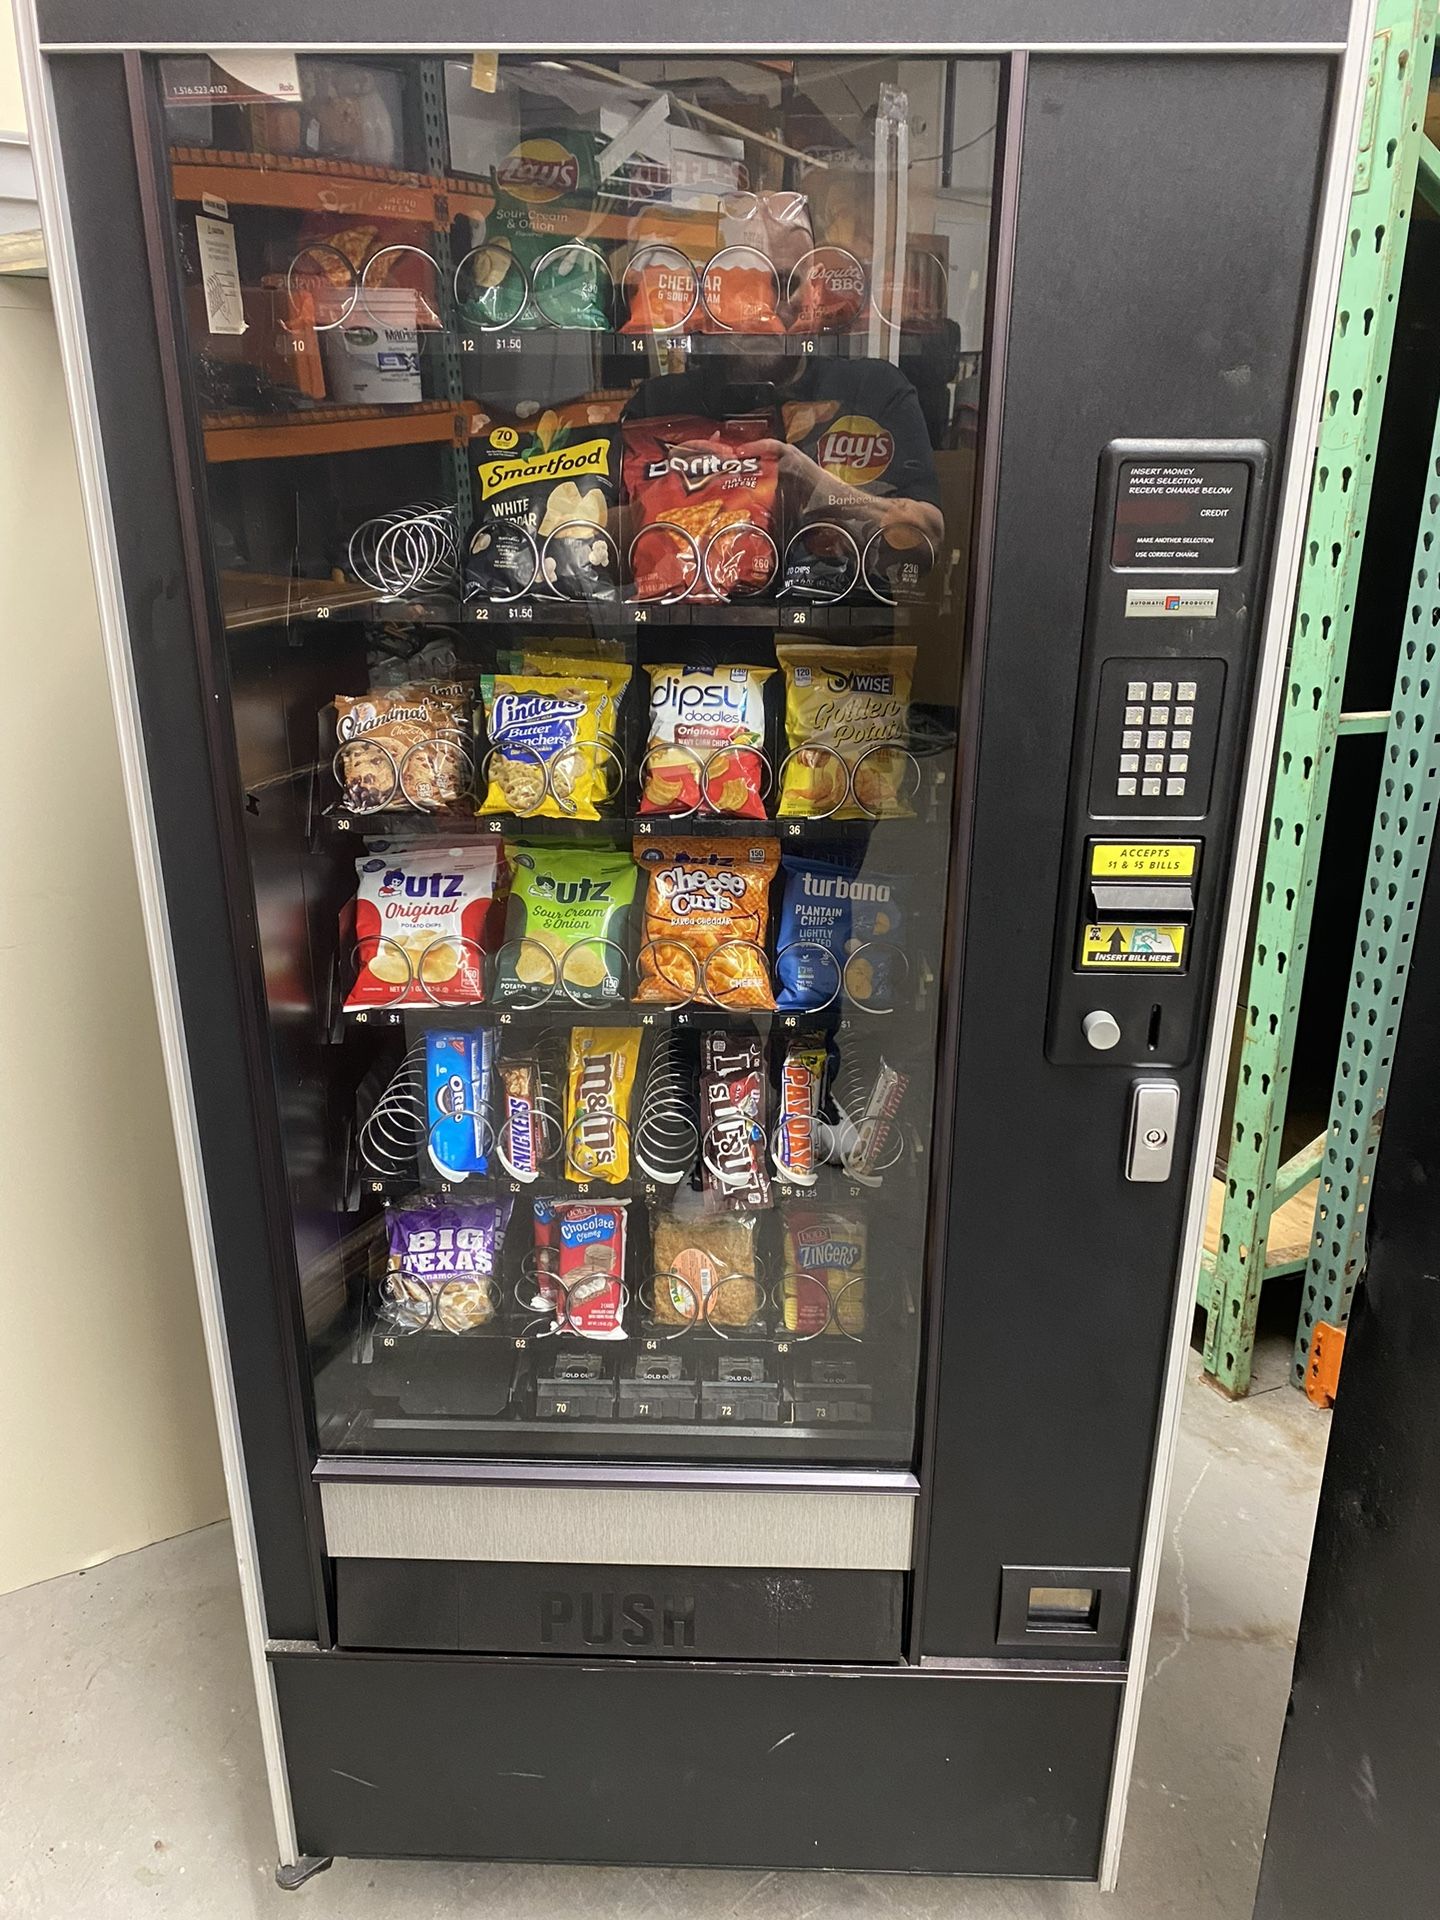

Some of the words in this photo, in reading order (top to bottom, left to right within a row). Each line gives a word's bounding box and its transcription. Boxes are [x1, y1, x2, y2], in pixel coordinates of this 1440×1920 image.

[173, 85, 228, 95] 1.516.523.4102
[279, 83, 294, 91] Rob
[501, 157, 574, 187] Lay's
[496, 209, 525, 220] Sour
[528, 210, 568, 222] Cream
[507, 219, 516, 229] &
[519, 219, 555, 231] Onion
[659, 274, 721, 291] CHEDAR
[831, 278, 863, 297] BBQ
[667, 291, 688, 302] SOUR
[292, 341, 305, 351] 10
[462, 340, 474, 350] 12
[496, 339, 521, 350] $1.50
[631, 339, 643, 351] 14
[802, 341, 813, 352] 16
[497, 430, 512, 442] 70
[823, 433, 888, 468] Lay's
[488, 447, 603, 487] Smartfood
[648, 456, 758, 478] Doritos
[1201, 487, 1233, 495] BELOW
[492, 499, 529, 517] WHITE
[1200, 509, 1229, 517] CREDIT
[753, 559, 769, 569] 260
[317, 607, 330, 618] 20
[476, 609, 488, 619] 22
[509, 608, 532, 619] $1.50
[634, 611, 646, 621] 24
[794, 613, 805, 623] 26
[796, 668, 810, 677] 120
[857, 676, 890, 693] WISE
[651, 677, 748, 722] dipsy
[492, 694, 588, 725] Linden's
[814, 698, 901, 731] Golden
[685, 710, 739, 723] doodles
[337, 705, 429, 745] Grandma's
[508, 725, 552, 738] Butter
[678, 727, 719, 736] Original
[338, 820, 349, 830] 30
[490, 822, 501, 832] 32
[640, 824, 651, 833] 34
[789, 825, 800, 834] 36
[1120, 849, 1170, 857] ACCEPTS
[1109, 861, 1117, 869] $1
[1135, 861, 1144, 869] $5
[655, 867, 747, 898] Cheese
[802, 872, 890, 902] turbana
[672, 893, 733, 915] Curls
[385, 899, 458, 923] Original
[533, 905, 563, 919] Sour
[565, 908, 606, 917] Cream
[795, 904, 842, 917] PLANTAIN
[543, 919, 552, 928] &
[553, 918, 591, 928] Onion
[801, 916, 835, 926] CHIPS
[800, 929, 833, 939] LIGHTLY
[1095, 953, 1128, 961] INSERT
[1128, 953, 1147, 961] BILL
[1149, 954, 1172, 962] HERE
[605, 980, 618, 988] 150
[729, 979, 763, 987] CHEESE
[356, 1014, 367, 1022] 40
[390, 1015, 400, 1023] $1
[500, 1015, 511, 1024] 42
[643, 1016, 653, 1025] 44
[679, 1014, 688, 1023] $1
[785, 1017, 796, 1026] 46
[841, 1021, 850, 1029] $1
[449, 1075, 465, 1123] OREO
[785, 1066, 812, 1169] PAYDAY
[509, 1098, 531, 1173] SNICKERS
[372, 1183, 382, 1192] 50
[442, 1184, 451, 1192] 51
[510, 1183, 520, 1192] 52
[579, 1183, 588, 1192] 53
[645, 1184, 655, 1193] 54
[782, 1186, 792, 1195] 56
[796, 1189, 817, 1198] $1.25
[850, 1187, 860, 1196] 57
[561, 1218, 615, 1239] Chocolate
[408, 1228, 484, 1252] BIG
[576, 1230, 602, 1242] Cremes
[384, 1339, 394, 1347] 60
[515, 1340, 525, 1348] 62
[646, 1341, 656, 1349] 64
[778, 1344, 788, 1352] 66
[556, 1404, 567, 1413] 70
[639, 1405, 649, 1414] 71
[722, 1407, 732, 1416] 72
[816, 1408, 826, 1417] 73
[540, 1592, 695, 1648] PUSH
